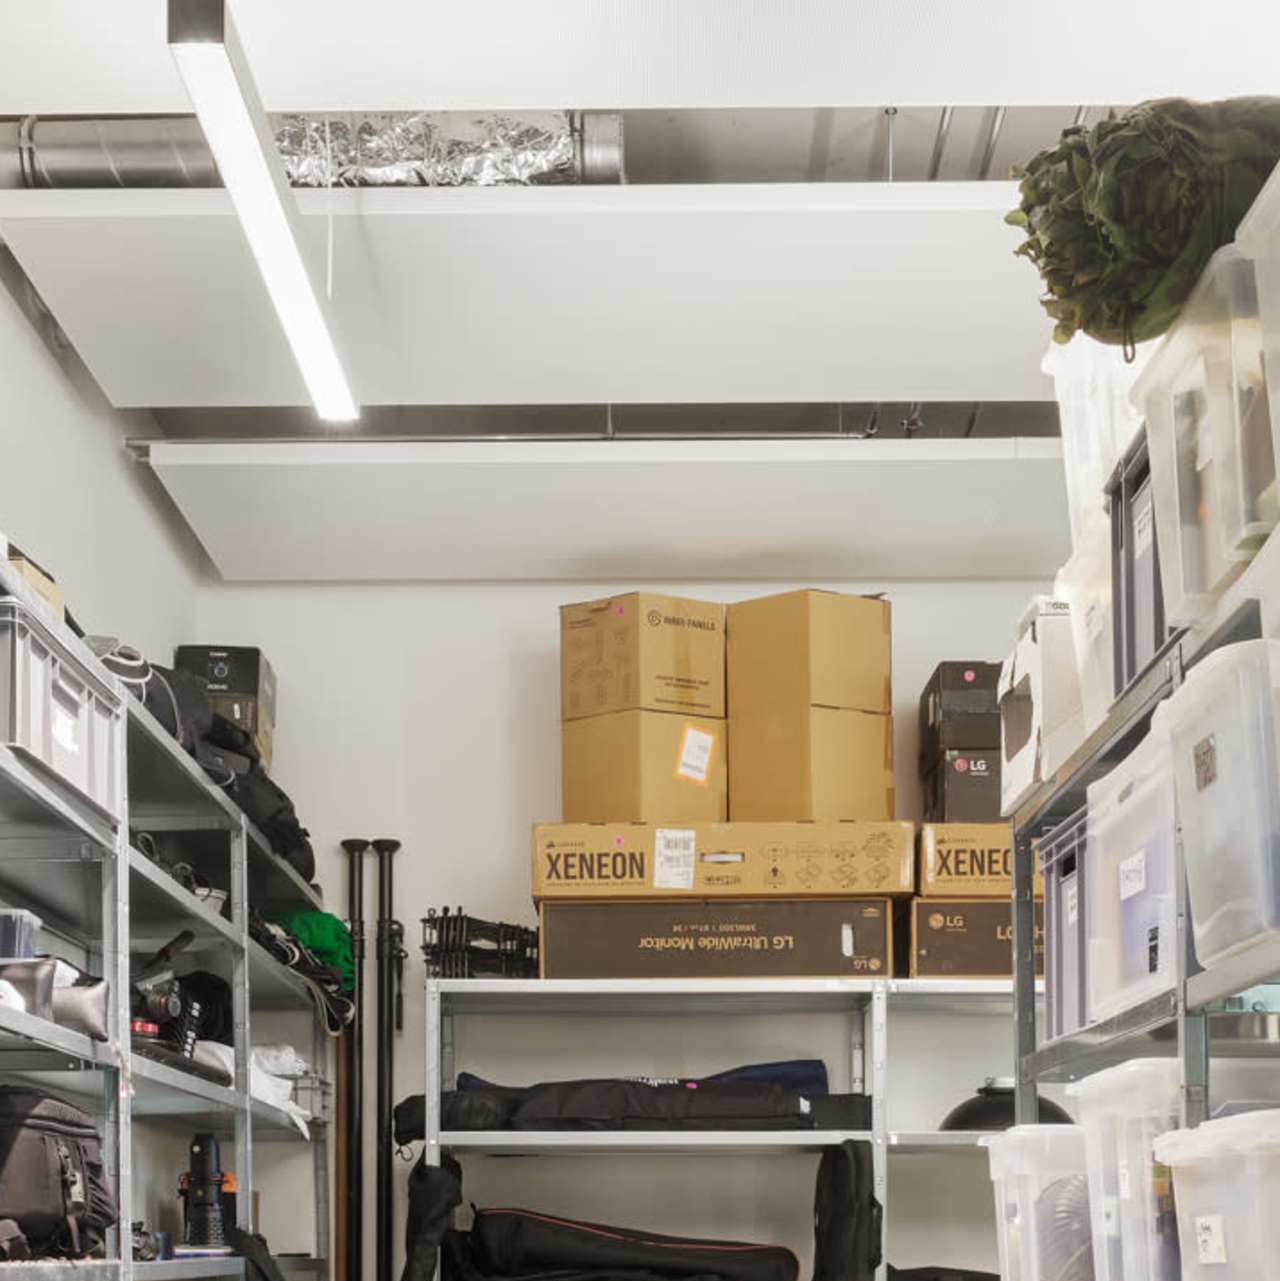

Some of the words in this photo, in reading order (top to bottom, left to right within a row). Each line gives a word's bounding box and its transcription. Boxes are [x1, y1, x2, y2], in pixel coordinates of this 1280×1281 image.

[970, 760, 987, 771] LG
[546, 851, 645, 880] XENEON
[936, 848, 1012, 876] XENE
[946, 915, 964, 927] LG
[638, 935, 694, 951] Monitor
[697, 935, 768, 950] UltraWide
[773, 935, 794, 950] LG
[854, 959, 868, 970] LG
